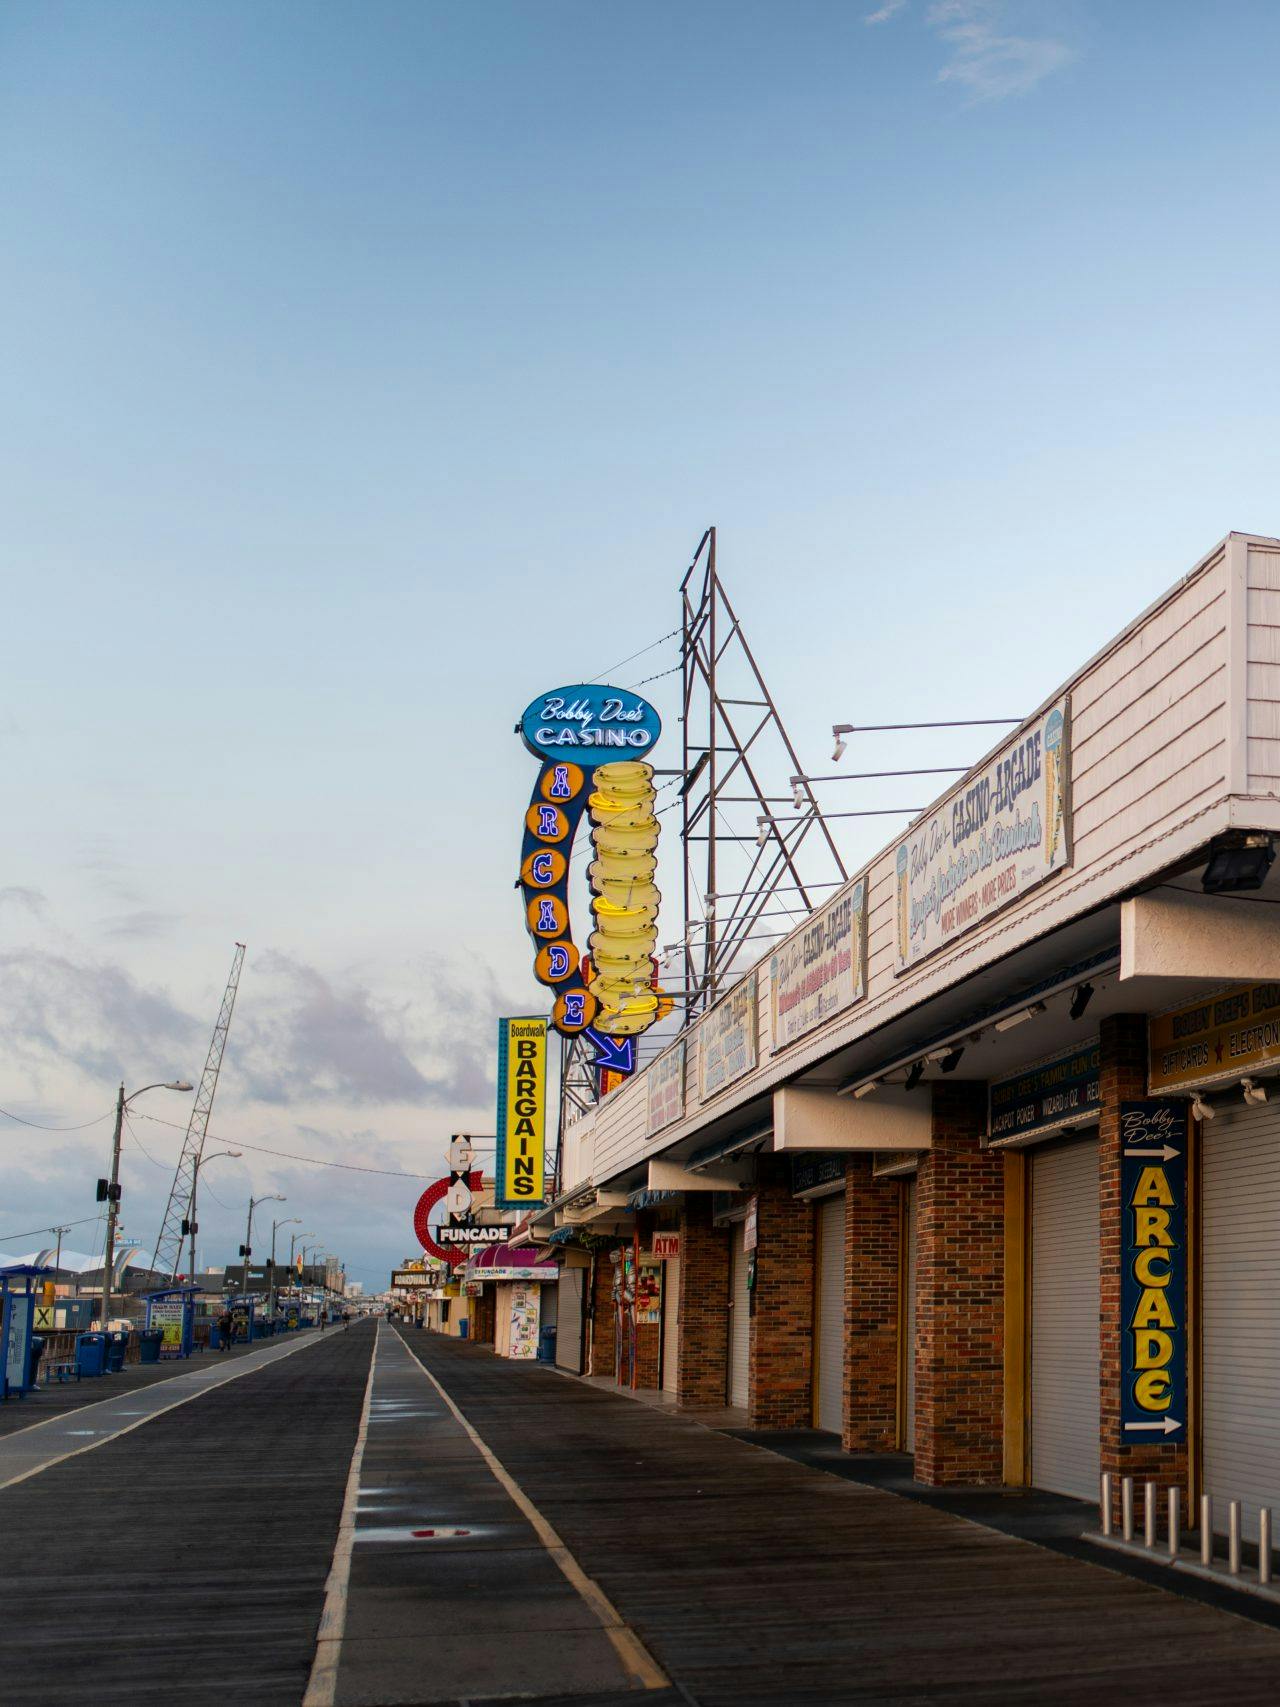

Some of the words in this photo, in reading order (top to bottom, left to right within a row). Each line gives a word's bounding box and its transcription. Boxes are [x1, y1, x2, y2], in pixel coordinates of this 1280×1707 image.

[540, 697, 594, 728] Bobby
[599, 699, 644, 723] Dee's
[534, 726, 652, 748] CASINO
[910, 837, 929, 886] Bobby
[952, 775, 991, 849] CASINO
[990, 729, 1042, 817] ARCADE
[992, 800, 1043, 862] Boardwalk
[531, 765, 586, 1026] ARCADE
[941, 908, 955, 937] MORE
[955, 892, 979, 927] WINNERS
[981, 876, 997, 909] MORE
[997, 862, 1017, 900] PRIZES
[511, 1023, 546, 1038] Boardwalk
[1161, 1049, 1180, 1077] GIFT
[1180, 1040, 1209, 1072] CARDS
[512, 1039, 539, 1196] BARGAINS
[992, 1111, 1015, 1134] JACKPOT
[1016, 1104, 1036, 1127] POKER
[1041, 1094, 1064, 1118] WIZARD
[1069, 1088, 1079, 1108] OZ
[1121, 1108, 1185, 1133] Bobby
[1124, 1127, 1184, 1144] Dee's
[440, 1227, 509, 1242] FUNCADE
[655, 1238, 679, 1254] ATM
[1130, 1166, 1177, 1411] ARCADE
